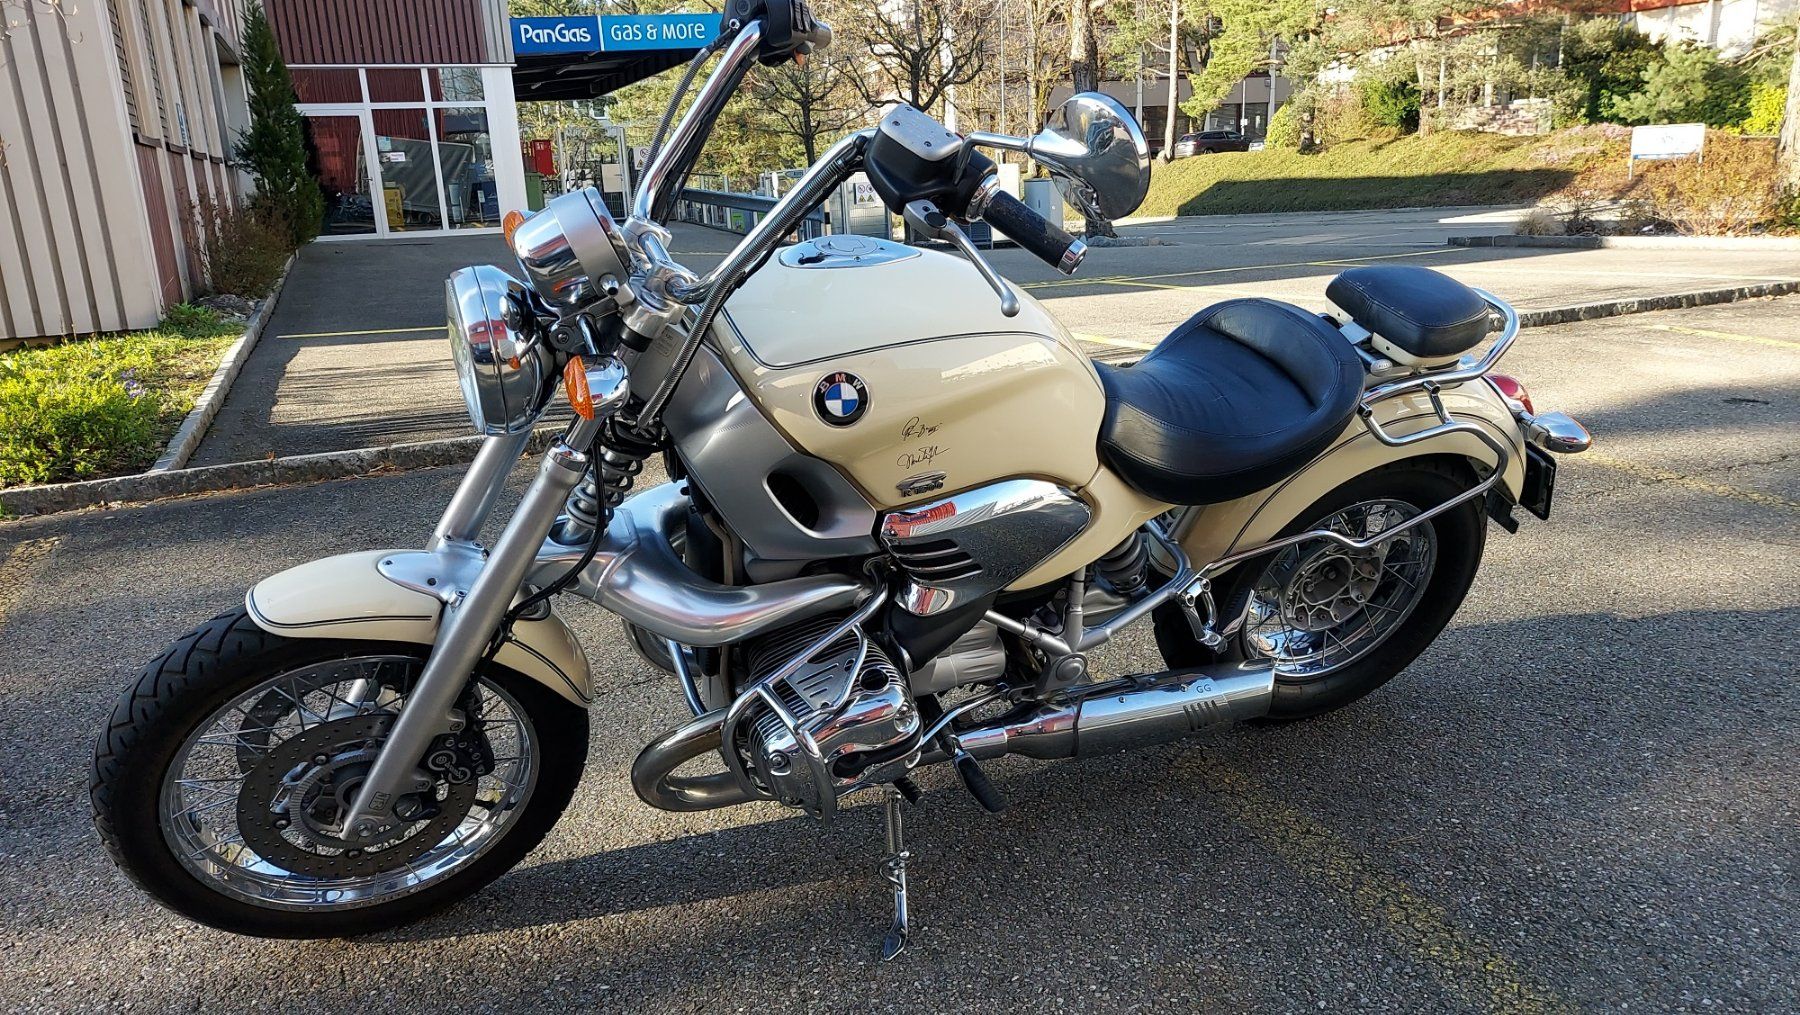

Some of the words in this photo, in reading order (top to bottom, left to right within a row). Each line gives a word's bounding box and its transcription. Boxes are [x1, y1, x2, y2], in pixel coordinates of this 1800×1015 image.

[520, 24, 592, 44] PanGas
[611, 24, 642, 42] Gas
[646, 24, 658, 41] &
[662, 23, 706, 41] More
[818, 373, 863, 394] BMW
[1196, 683, 1212, 693] GG
